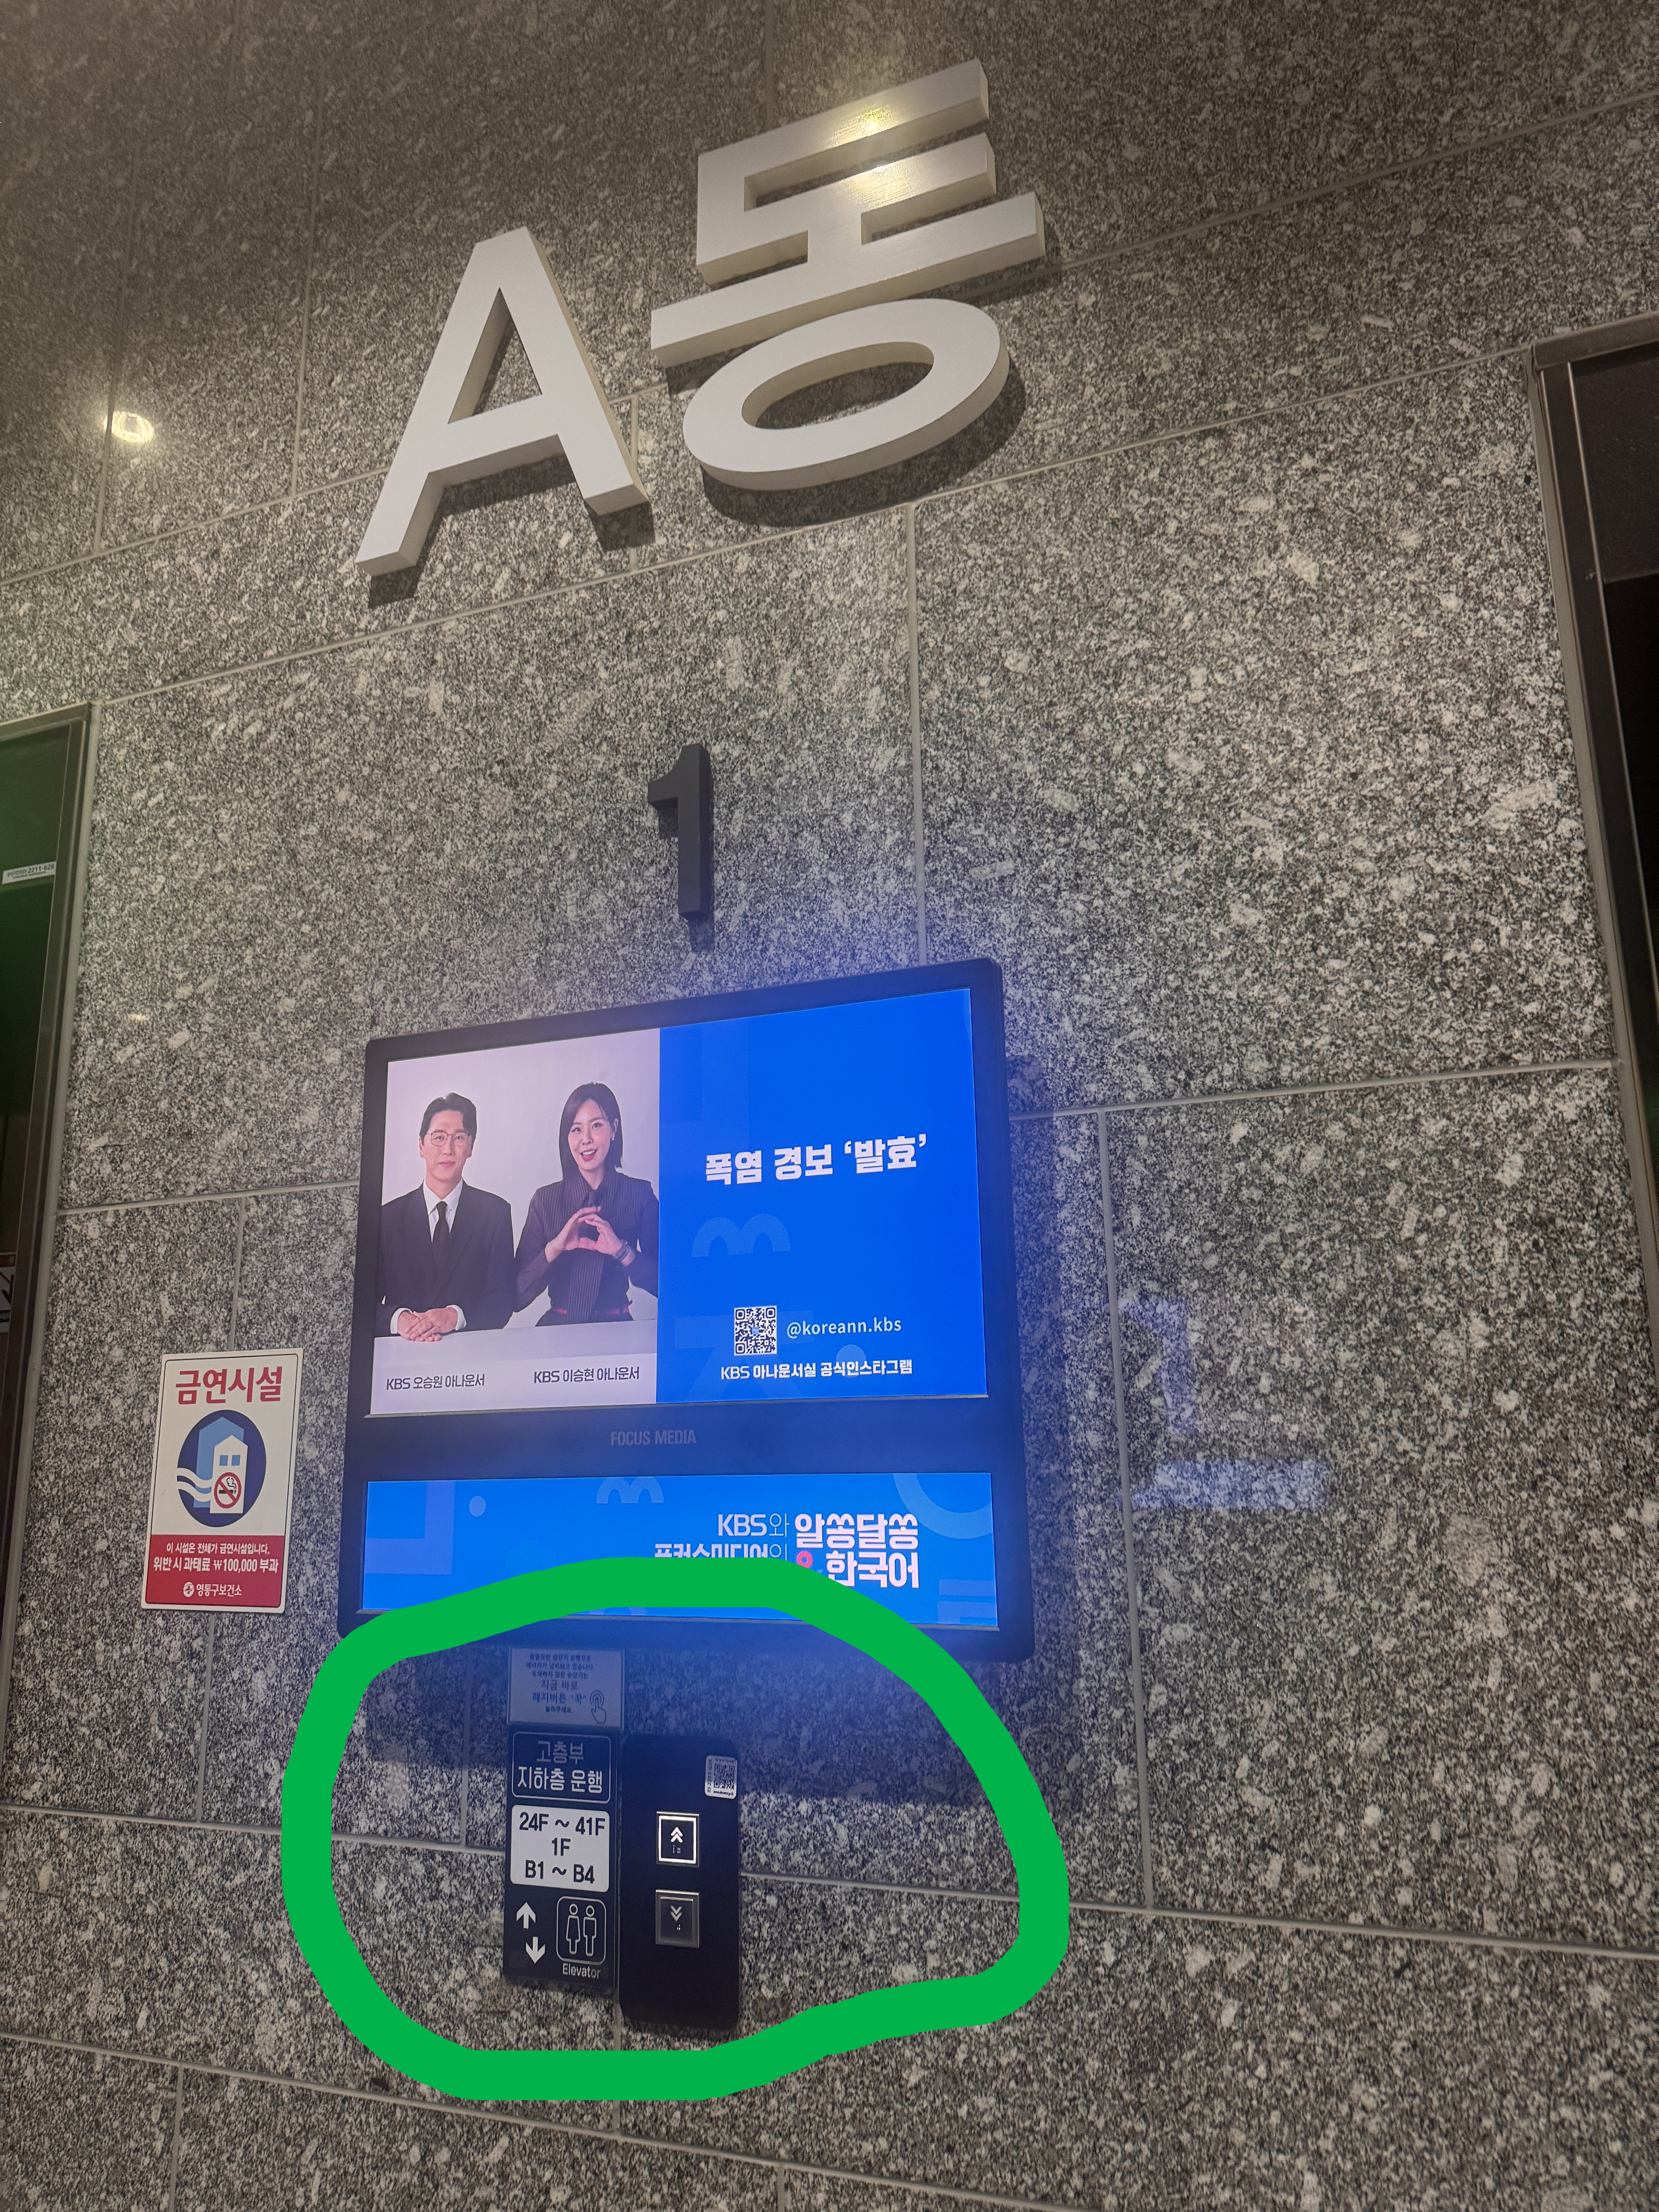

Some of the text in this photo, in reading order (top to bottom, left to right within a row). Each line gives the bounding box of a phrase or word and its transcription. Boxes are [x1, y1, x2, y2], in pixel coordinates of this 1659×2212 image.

[355, 59, 1044, 578] A동
[648, 744, 711, 921] 1
[706, 1150, 762, 1185] 폭염
[775, 1144, 833, 1180] 경보
[787, 1317, 902, 1339] @koreann.kbs
[534, 1366, 639, 1383] KBS 이승현 아나운서
[721, 1359, 912, 1379] KBS 아나운서실 공식인스타그램
[175, 1366, 282, 1405] 금연시설
[386, 1374, 485, 1390] KBS 오승원 아나운서
[611, 1429, 697, 1446] FOCUS MEDIA
[718, 1513, 789, 1537] KBS와
[795, 1513, 918, 1549] 알쏭달쏭
[166, 1542, 270, 1554] 이 시설은 전체가 금연시설입니다.
[153, 1556, 172, 1571] 위반
[173, 1557, 182, 1571] 시
[184, 1558, 211, 1572] 과태료
[260, 1559, 279, 1573] 부과
[826, 1550, 919, 1588] 한국어
[196, 1583, 242, 1597] 영통구보건소
[541, 1680, 578, 1691] 지금 바로
[537, 1741, 584, 1765] 고층부
[517, 1766, 602, 1793] 지하층 운행
[519, 1812, 549, 1831] 24F
[575, 1817, 606, 1836] 41F
[551, 1838, 571, 1856] 1F
[525, 1860, 544, 1879] B1
[574, 1864, 595, 1884] B4
[563, 1963, 601, 1979] Elevator
